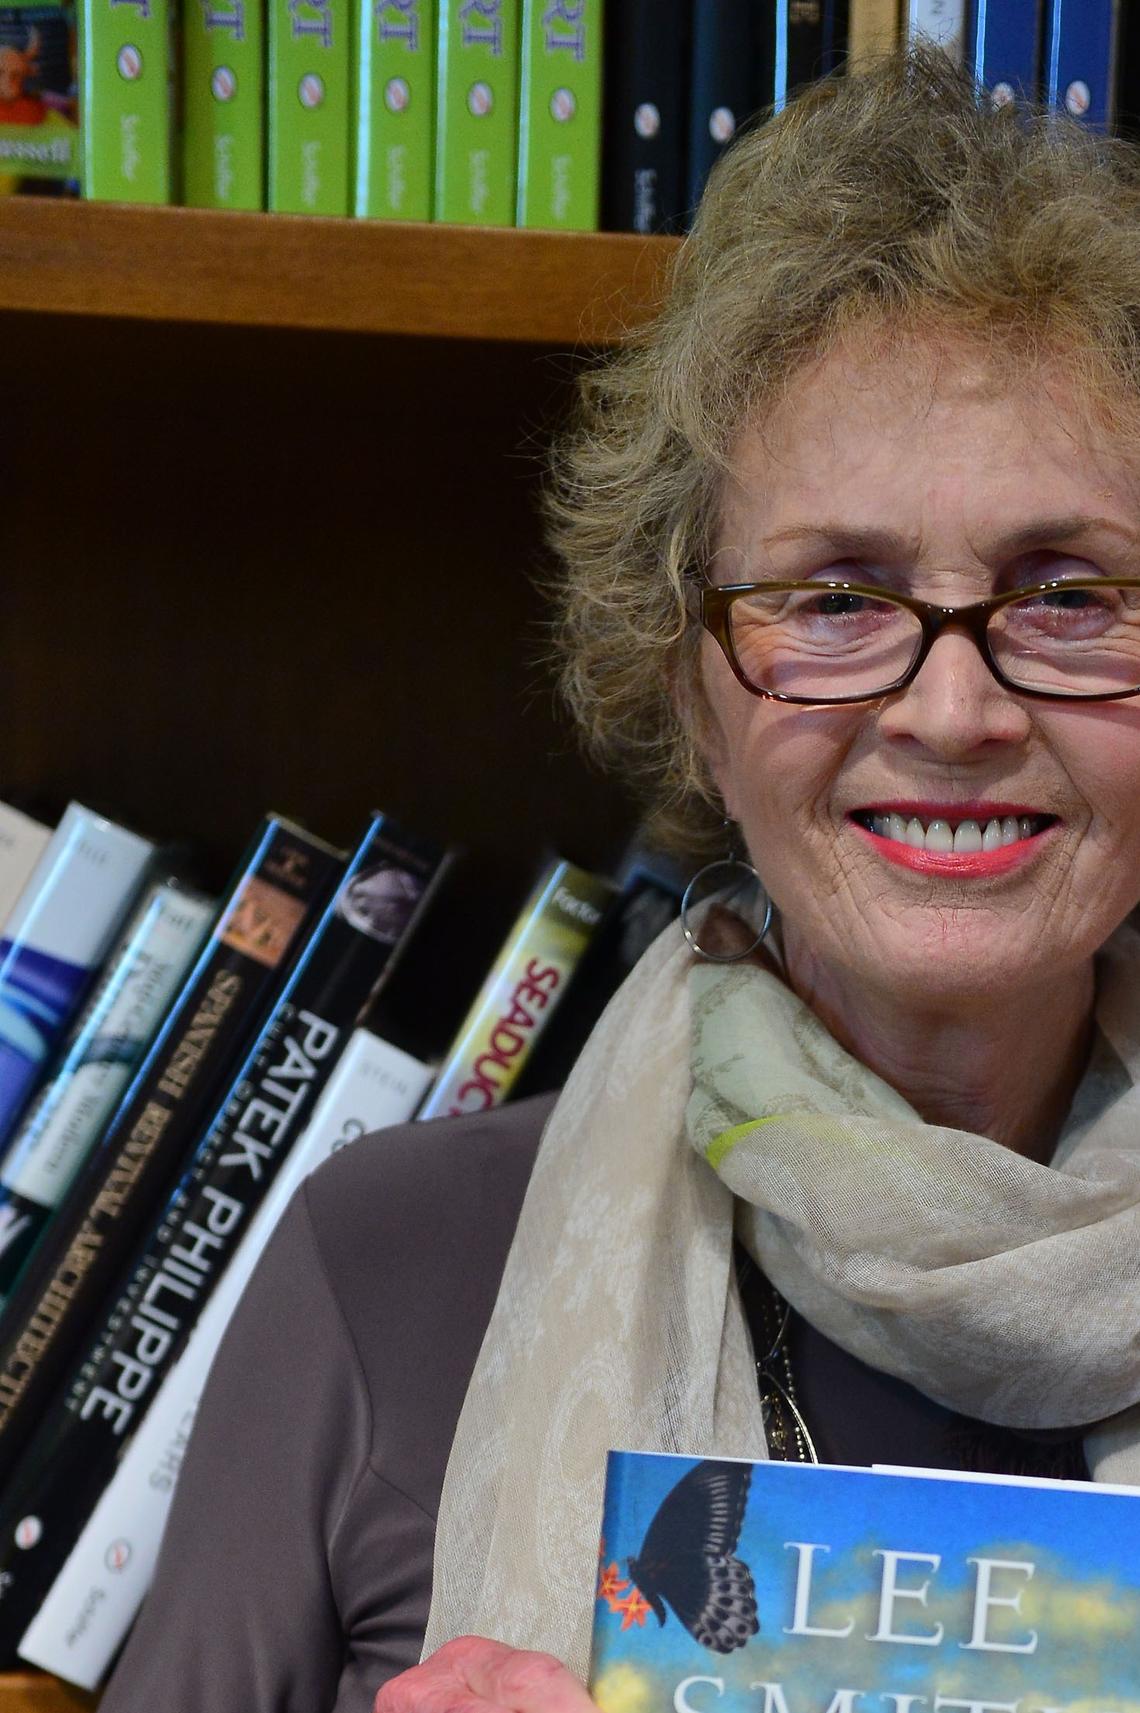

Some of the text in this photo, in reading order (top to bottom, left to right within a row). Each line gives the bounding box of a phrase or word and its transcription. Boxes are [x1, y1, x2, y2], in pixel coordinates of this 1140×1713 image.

[157, 969, 241, 1098] SPANISH
[218, 1009, 340, 1182] PATEK
[448, 957, 560, 1118] SEADUC
[88, 1102, 173, 1218] REVIVAL
[67, 1253, 159, 1412] INVESTMENT
[80, 1185, 244, 1435] PHILIPPE
[782, 1541, 1039, 1655] LEE
